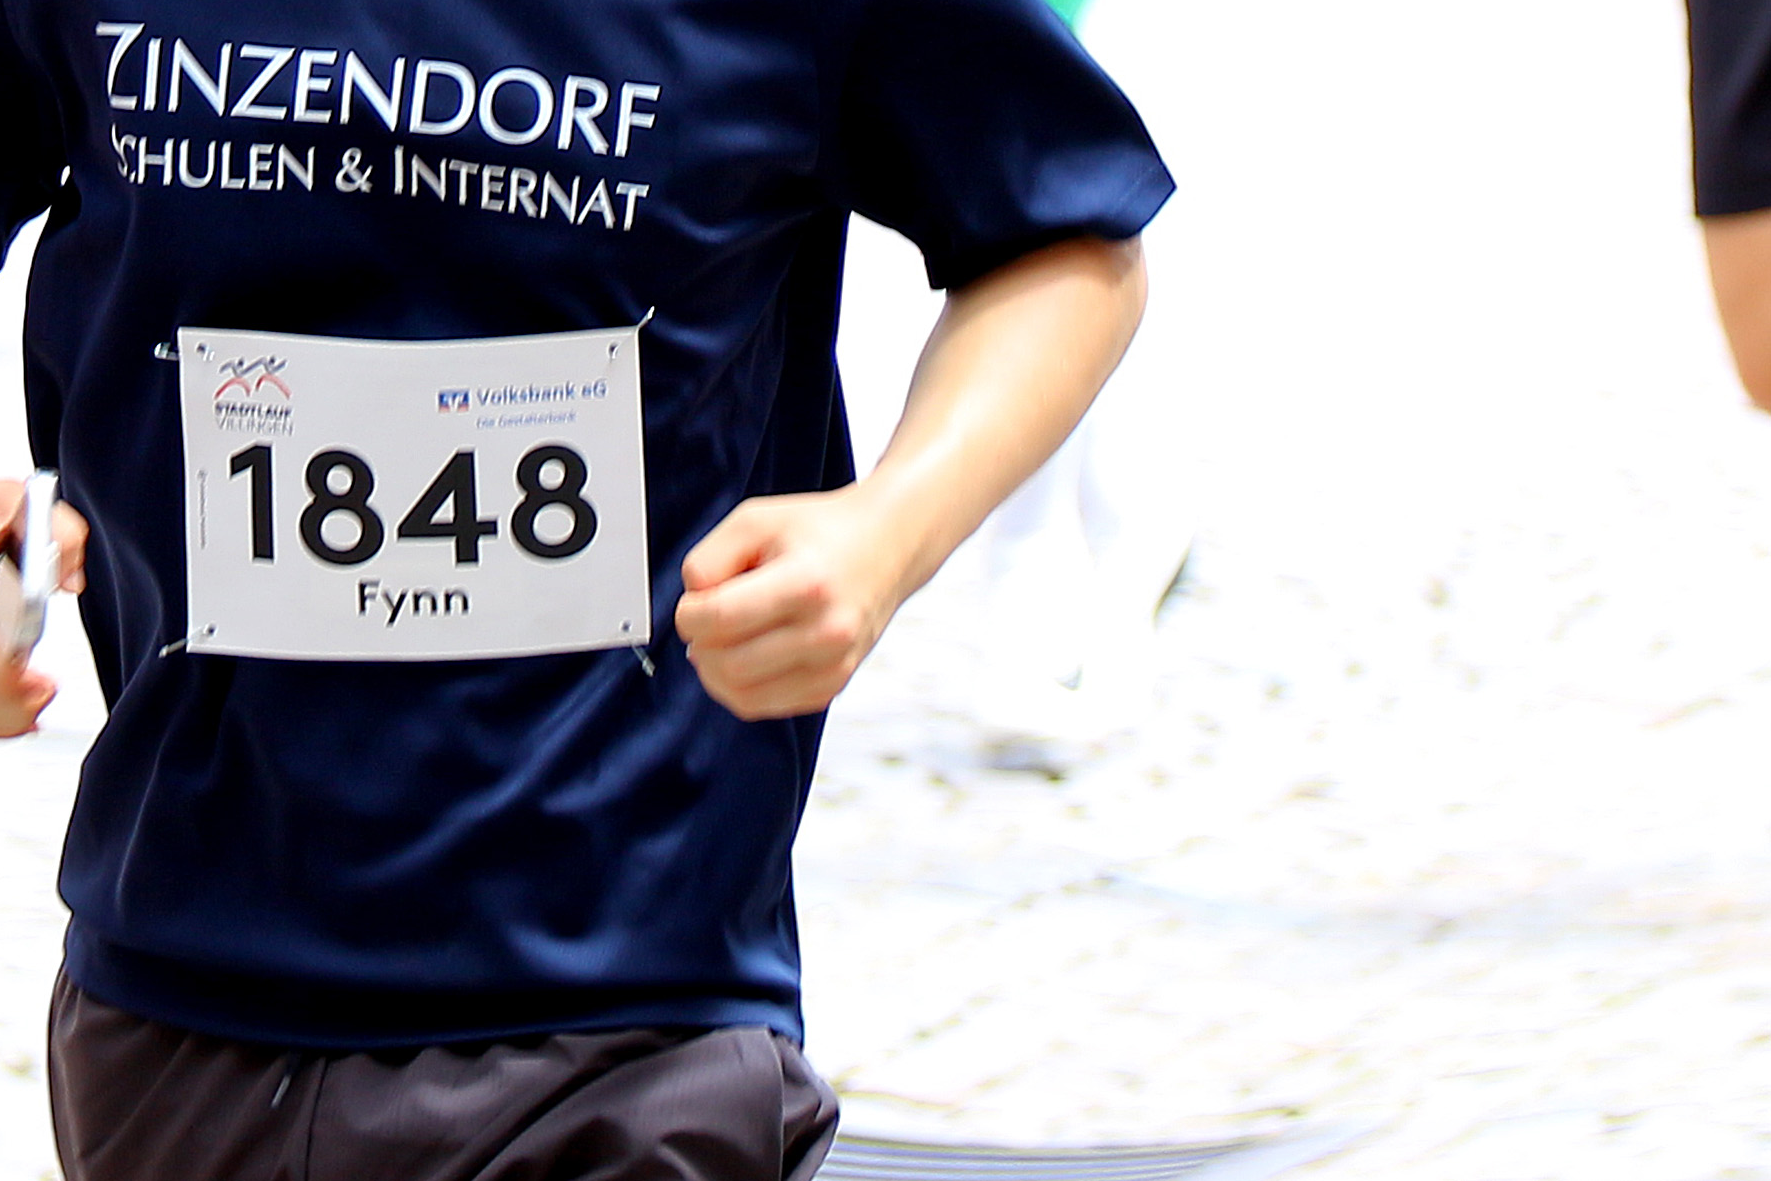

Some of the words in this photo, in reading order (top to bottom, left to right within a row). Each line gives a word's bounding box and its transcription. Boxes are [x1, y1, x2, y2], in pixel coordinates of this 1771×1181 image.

[96, 22, 661, 157] ZINZENDORF
[334, 147, 373, 193] &
[393, 145, 650, 231] INTERNAT
[478, 380, 576, 406] Volksbank
[229, 444, 598, 566] 1848
[358, 580, 470, 626] Fynn
